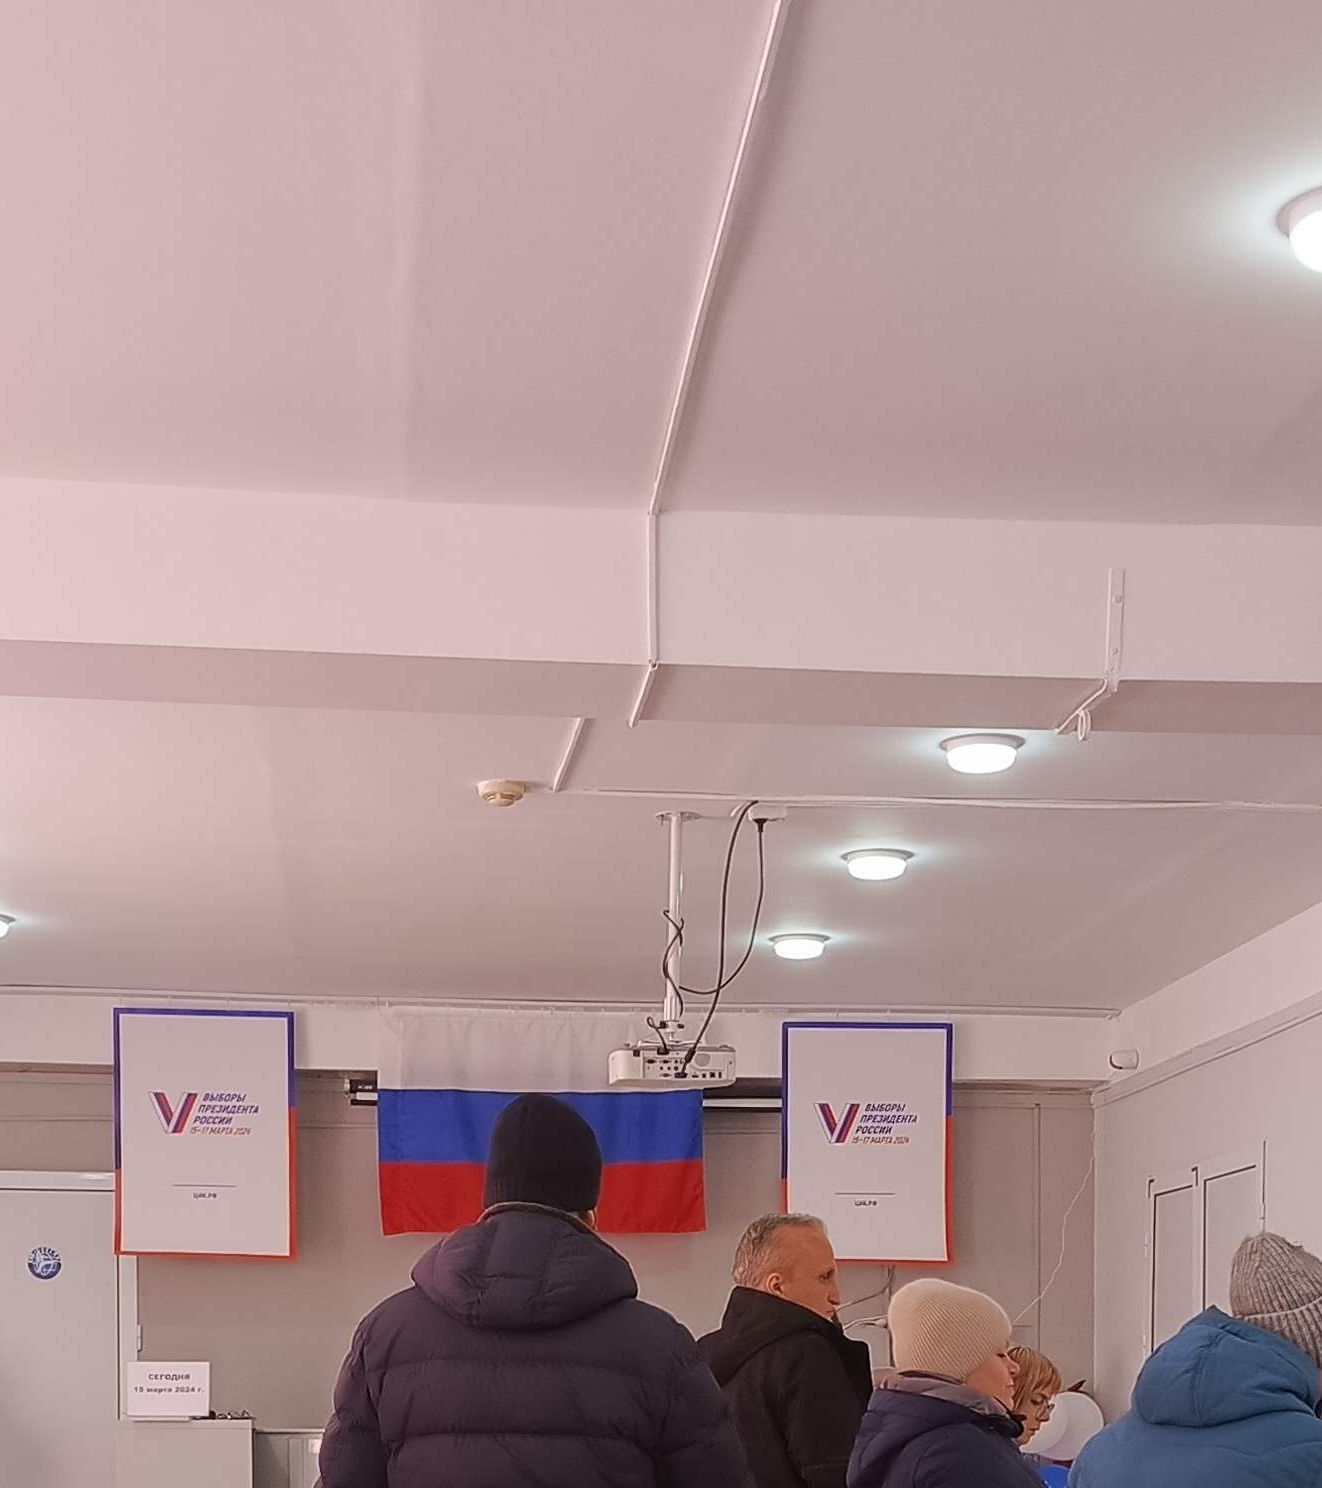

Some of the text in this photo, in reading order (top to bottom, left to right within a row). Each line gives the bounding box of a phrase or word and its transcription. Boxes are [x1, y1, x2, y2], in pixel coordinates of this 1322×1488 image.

[202, 1093, 247, 1102] ВЫБОРЫ
[197, 1104, 260, 1115] ПРЕЗИДЕНТА
[865, 1103, 906, 1112] ВЫБОРЫ
[193, 1116, 233, 1125] РОССИИ
[859, 1114, 918, 1124] ПРЕЗИДЕНТА
[855, 1126, 893, 1134] РОССИИ
[148, 1373, 190, 1381] СЕГОДНЯ
